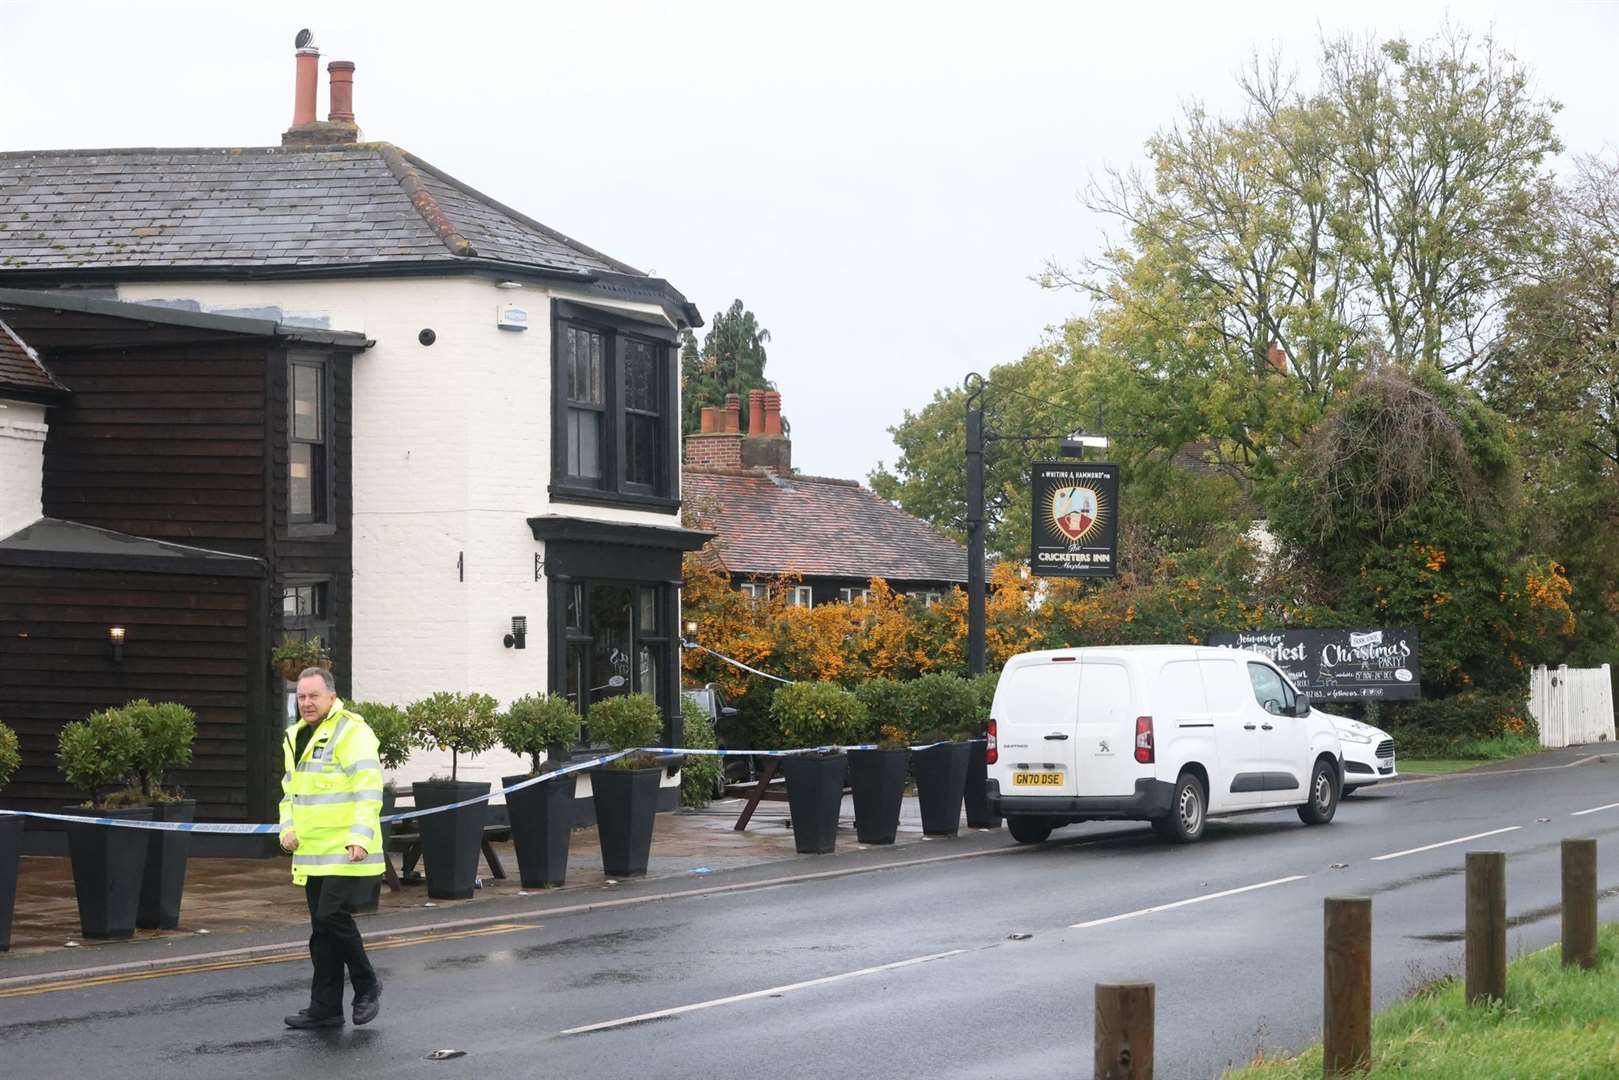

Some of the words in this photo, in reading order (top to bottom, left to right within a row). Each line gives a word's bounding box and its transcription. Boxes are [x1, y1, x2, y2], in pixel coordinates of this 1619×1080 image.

[1038, 552, 1090, 562] CRICKETERS
[1092, 553, 1110, 562] INN
[1218, 642, 1308, 661] erfest
[1322, 639, 1411, 668] Christmas
[1379, 656, 1406, 668] PARTY!
[1016, 775, 1040, 785] GN70
[1041, 775, 1060, 785] DSE
